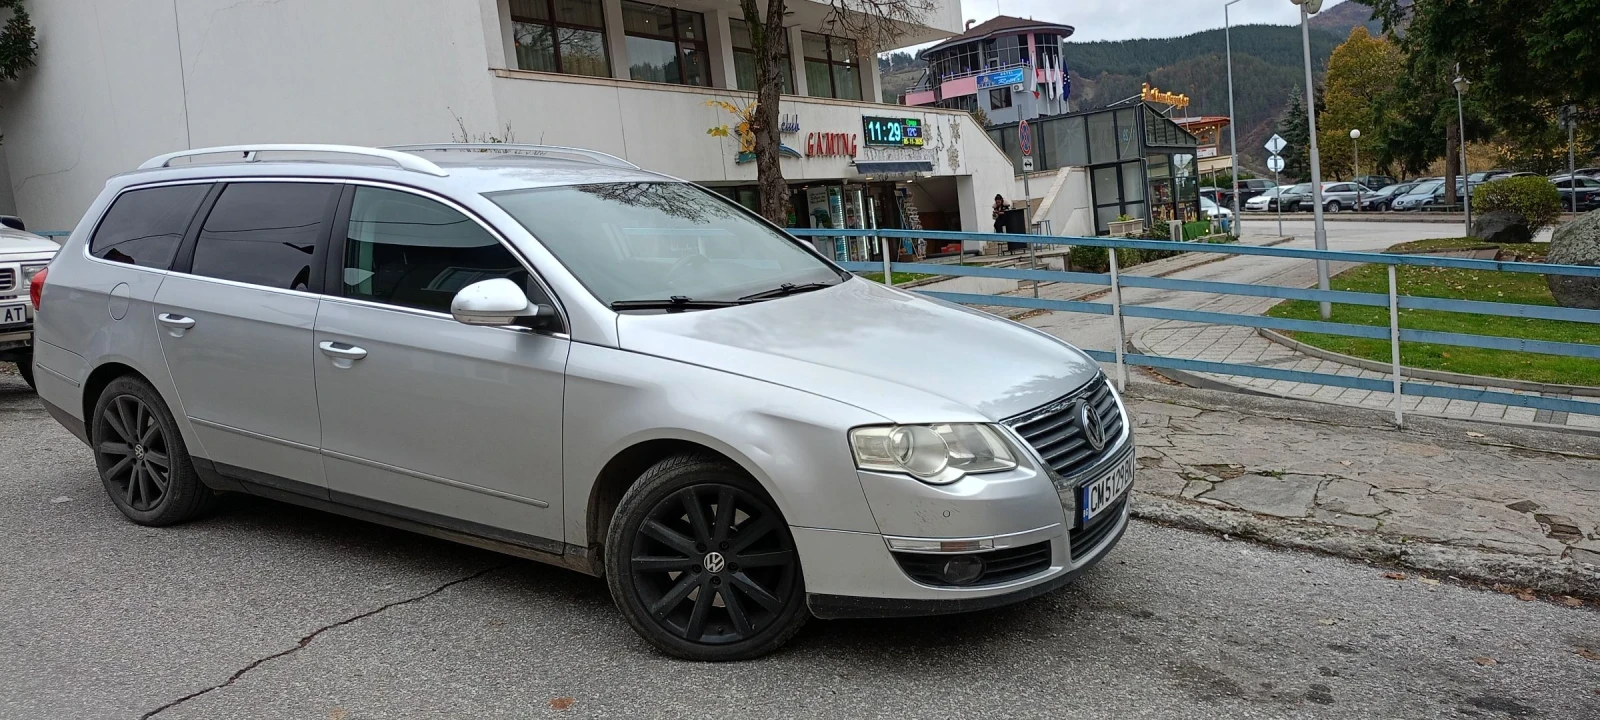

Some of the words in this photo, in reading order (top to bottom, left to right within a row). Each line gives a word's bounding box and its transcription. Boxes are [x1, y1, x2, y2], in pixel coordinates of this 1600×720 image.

[781, 114, 800, 132] club
[868, 121, 901, 142] 11:29
[807, 132, 857, 158] GAMING
[5, 308, 22, 322] AT
